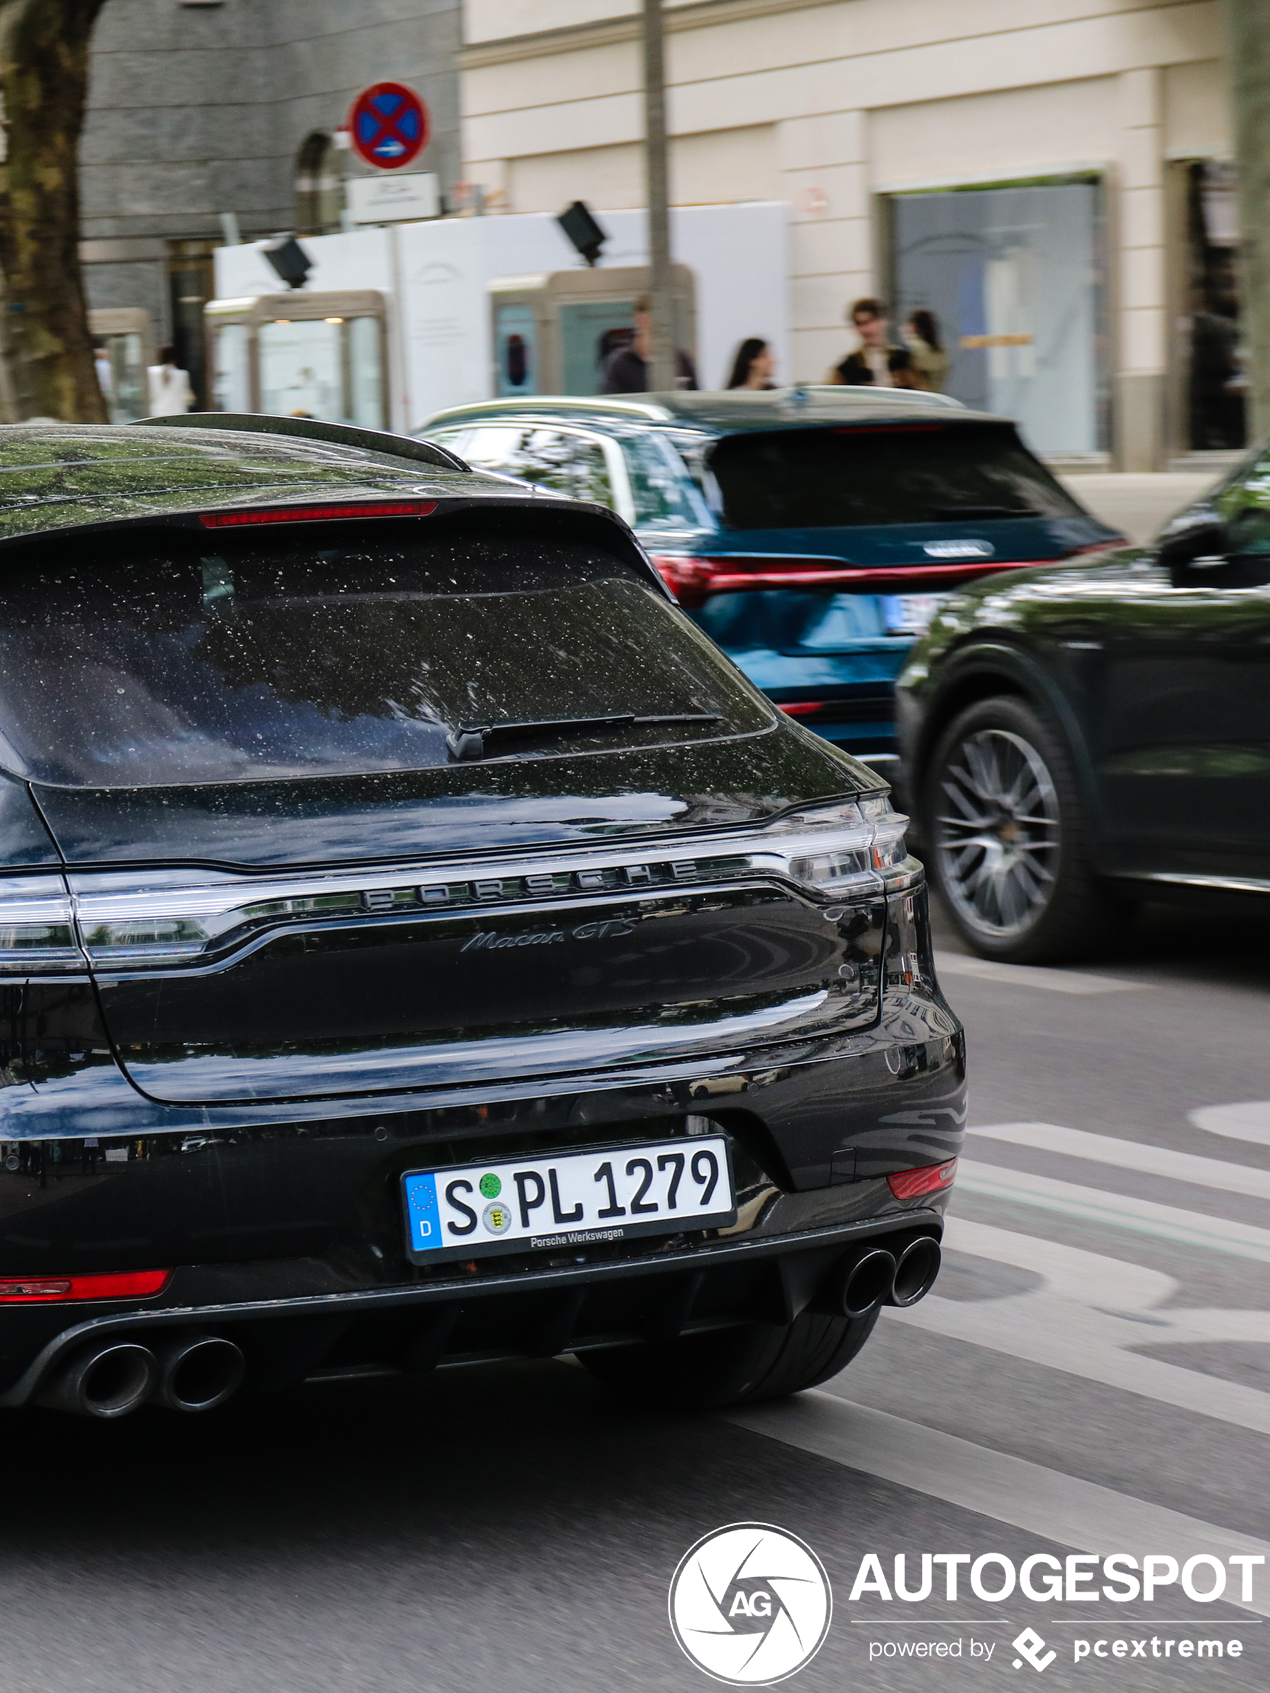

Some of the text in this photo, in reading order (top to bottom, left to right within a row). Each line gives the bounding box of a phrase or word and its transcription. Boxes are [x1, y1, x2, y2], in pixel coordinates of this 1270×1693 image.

[364, 860, 697, 910] PORSCHE
[460, 916, 639, 953] Macan GTS
[445, 1150, 719, 1236] S PL 1279
[420, 1220, 432, 1237] D
[530, 1228, 624, 1248] Porsche Werkswagen
